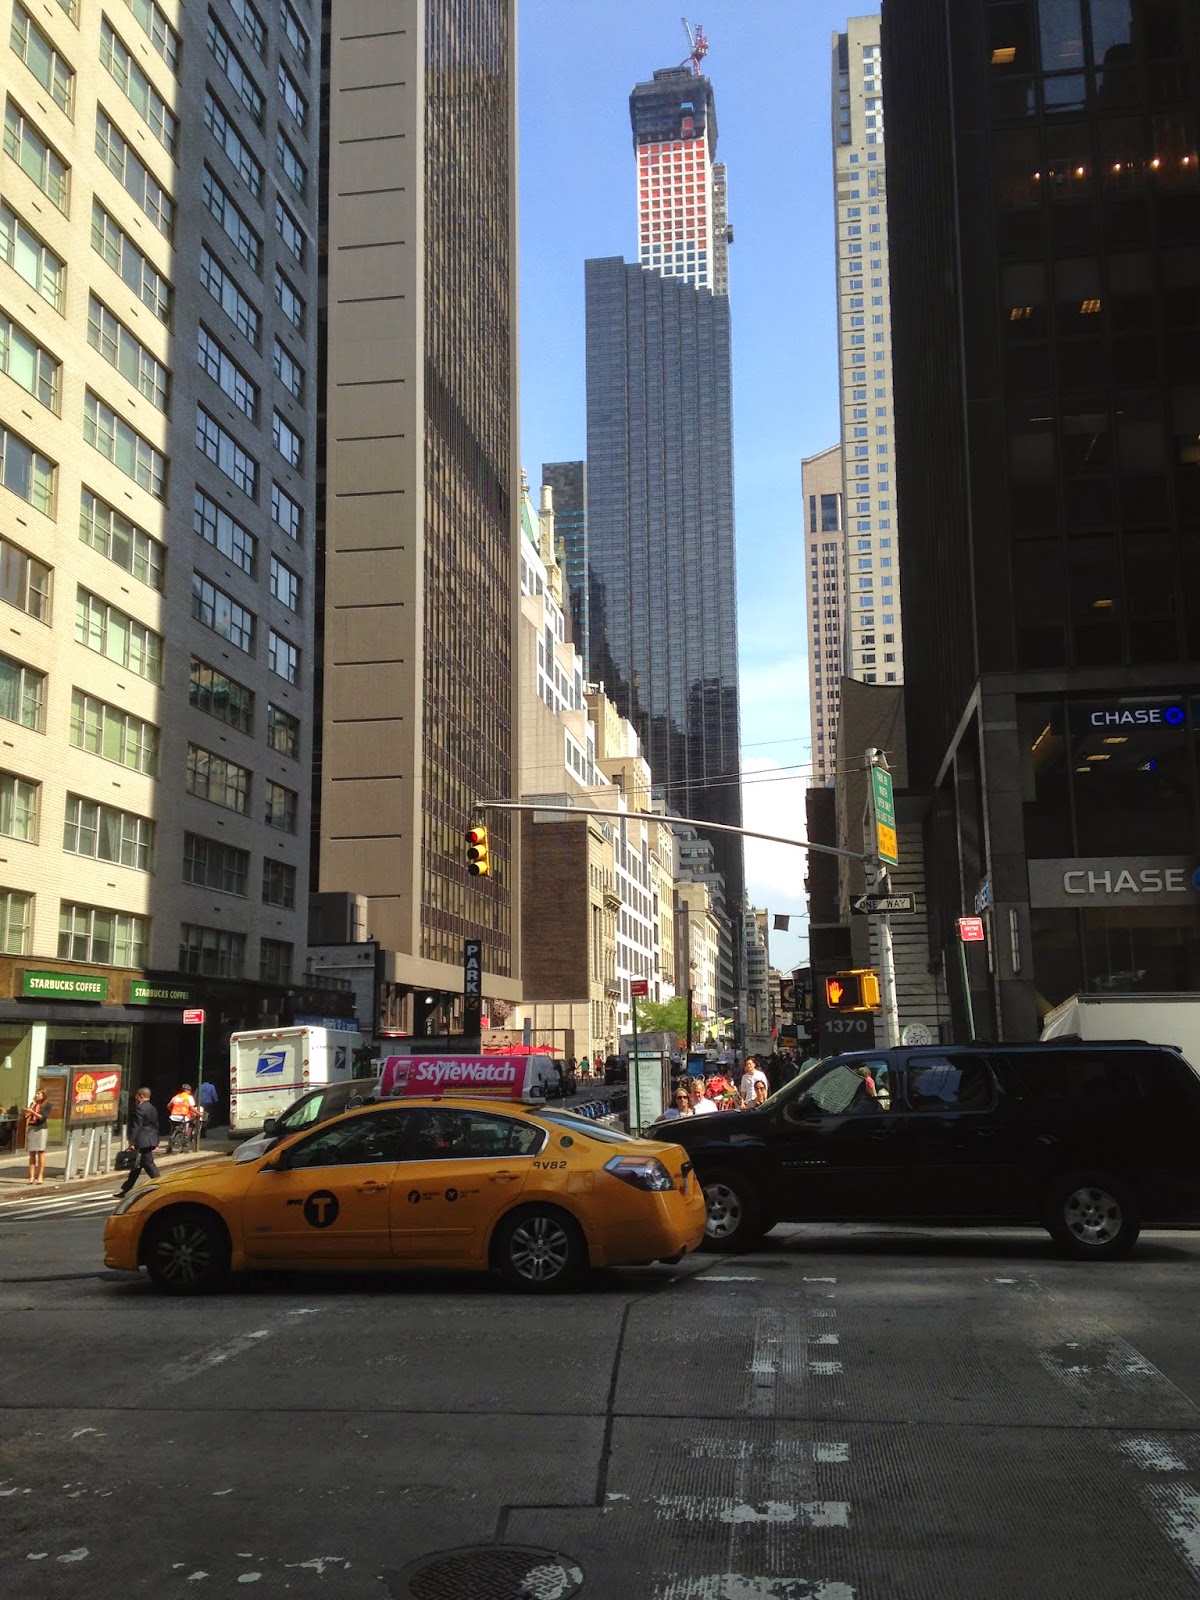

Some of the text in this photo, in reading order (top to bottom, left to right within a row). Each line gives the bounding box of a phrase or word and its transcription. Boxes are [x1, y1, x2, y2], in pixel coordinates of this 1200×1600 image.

[1091, 709, 1162, 726] CHASE
[1063, 869, 1187, 894] CHASE
[860, 899, 906, 909] ONE WAY
[466, 945, 479, 993] PARK
[29, 978, 101, 993] STARBUCKS COFFEE
[135, 987, 189, 1000] STARBUCKS COFFEE
[825, 1020, 868, 1033] 1370
[416, 1061, 516, 1086] StyleWatch
[533, 1160, 567, 1170] 9V82
[312, 1197, 332, 1223] T
